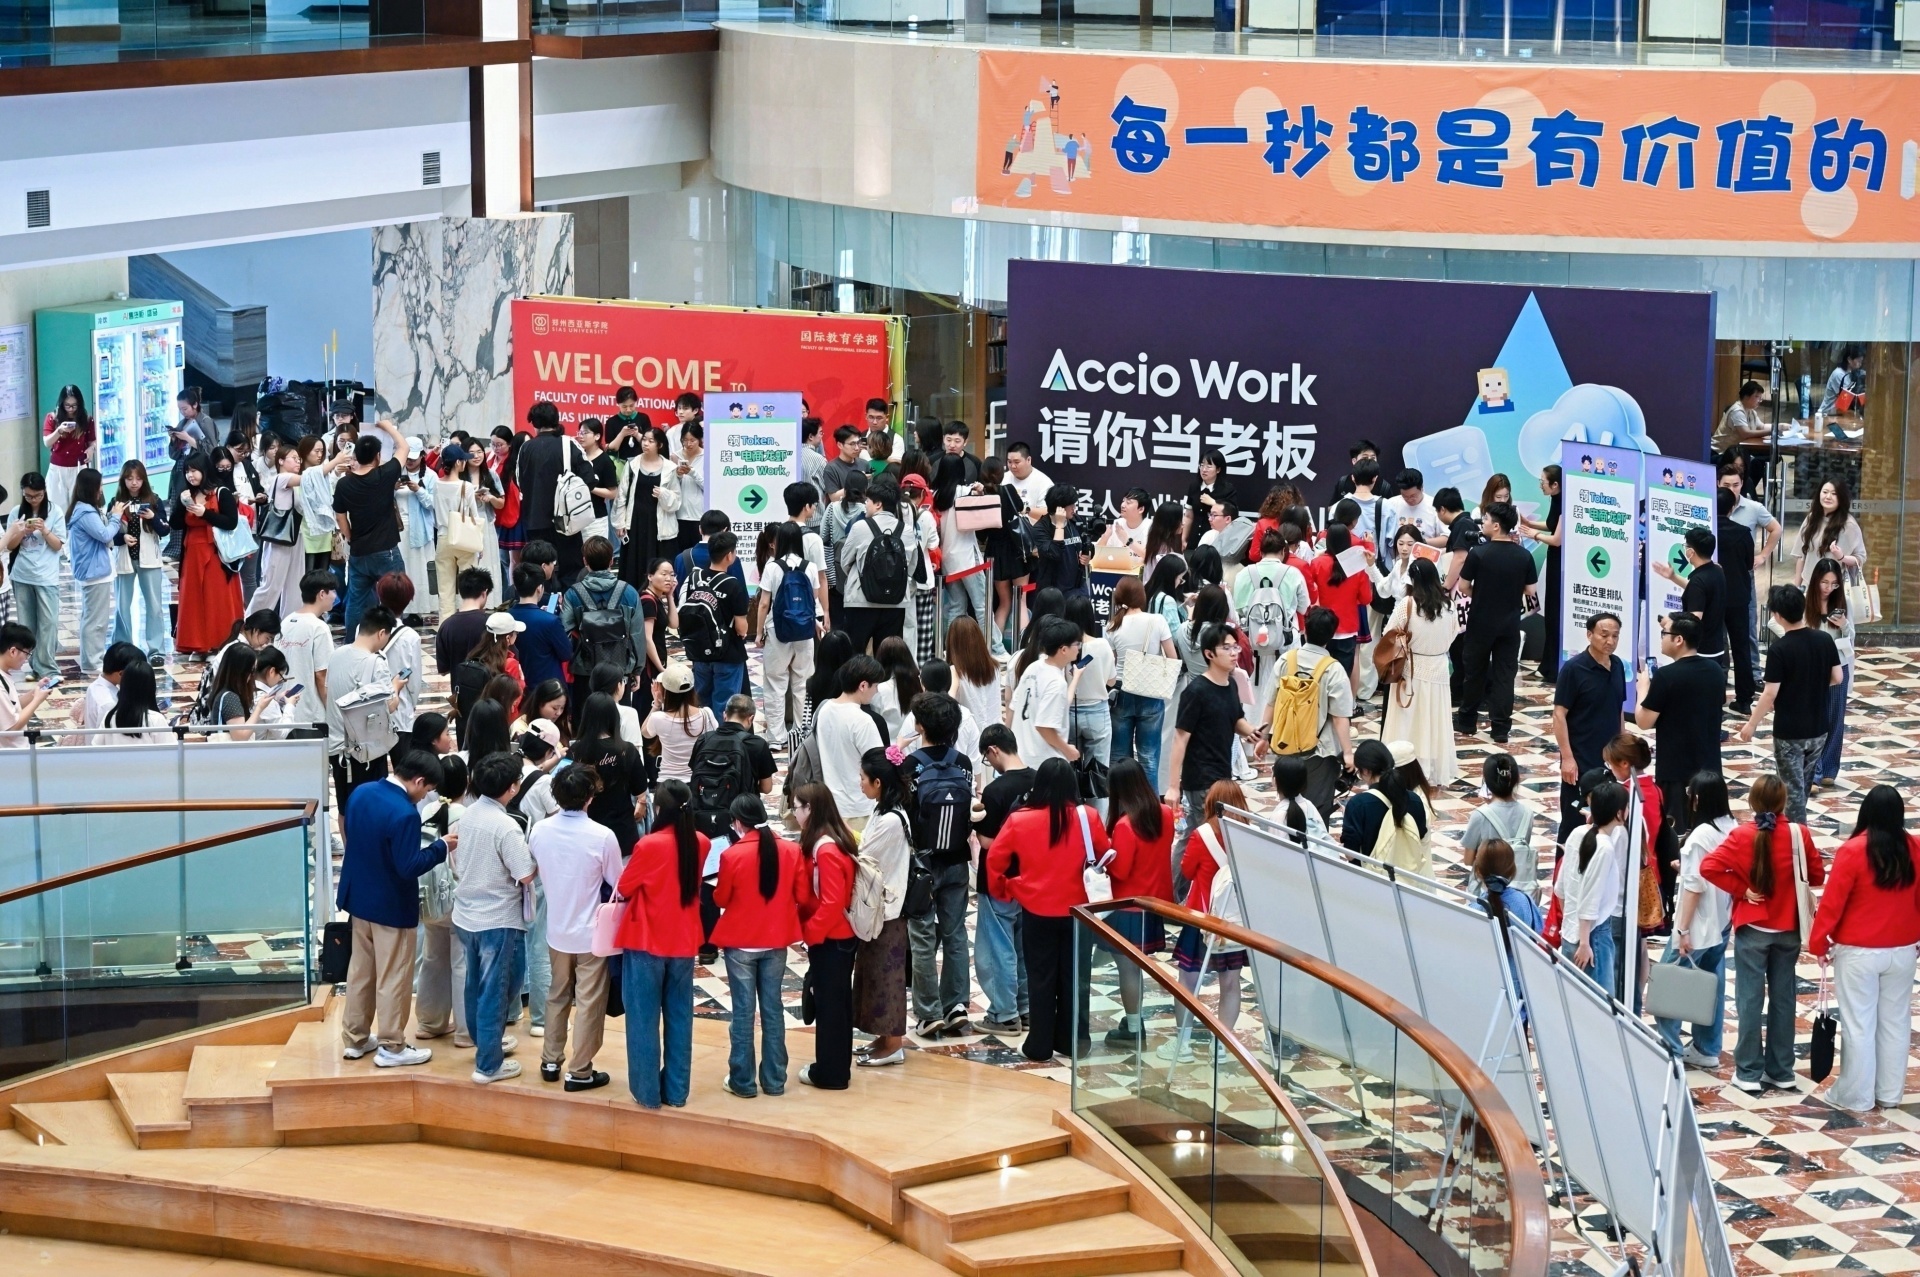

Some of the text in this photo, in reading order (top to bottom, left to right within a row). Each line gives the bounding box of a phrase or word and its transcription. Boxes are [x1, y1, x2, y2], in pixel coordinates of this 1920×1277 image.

[1110, 96, 1888, 194] 每一秒都是有价值的
[552, 319, 609, 330] 郑州西亚斯学院
[801, 330, 879, 346] 国际教育学部
[533, 350, 748, 392] WELCOME TO
[1040, 348, 1318, 406] Accio Work
[534, 390, 578, 404] FACULTY
[580, 393, 595, 405] OF
[558, 411, 575, 423] IAS
[1038, 406, 1318, 481] 请你当老板
[722, 464, 755, 476] Accio
[1575, 522, 1600, 537] Accio
[1573, 582, 1623, 602] 请在这里排队
